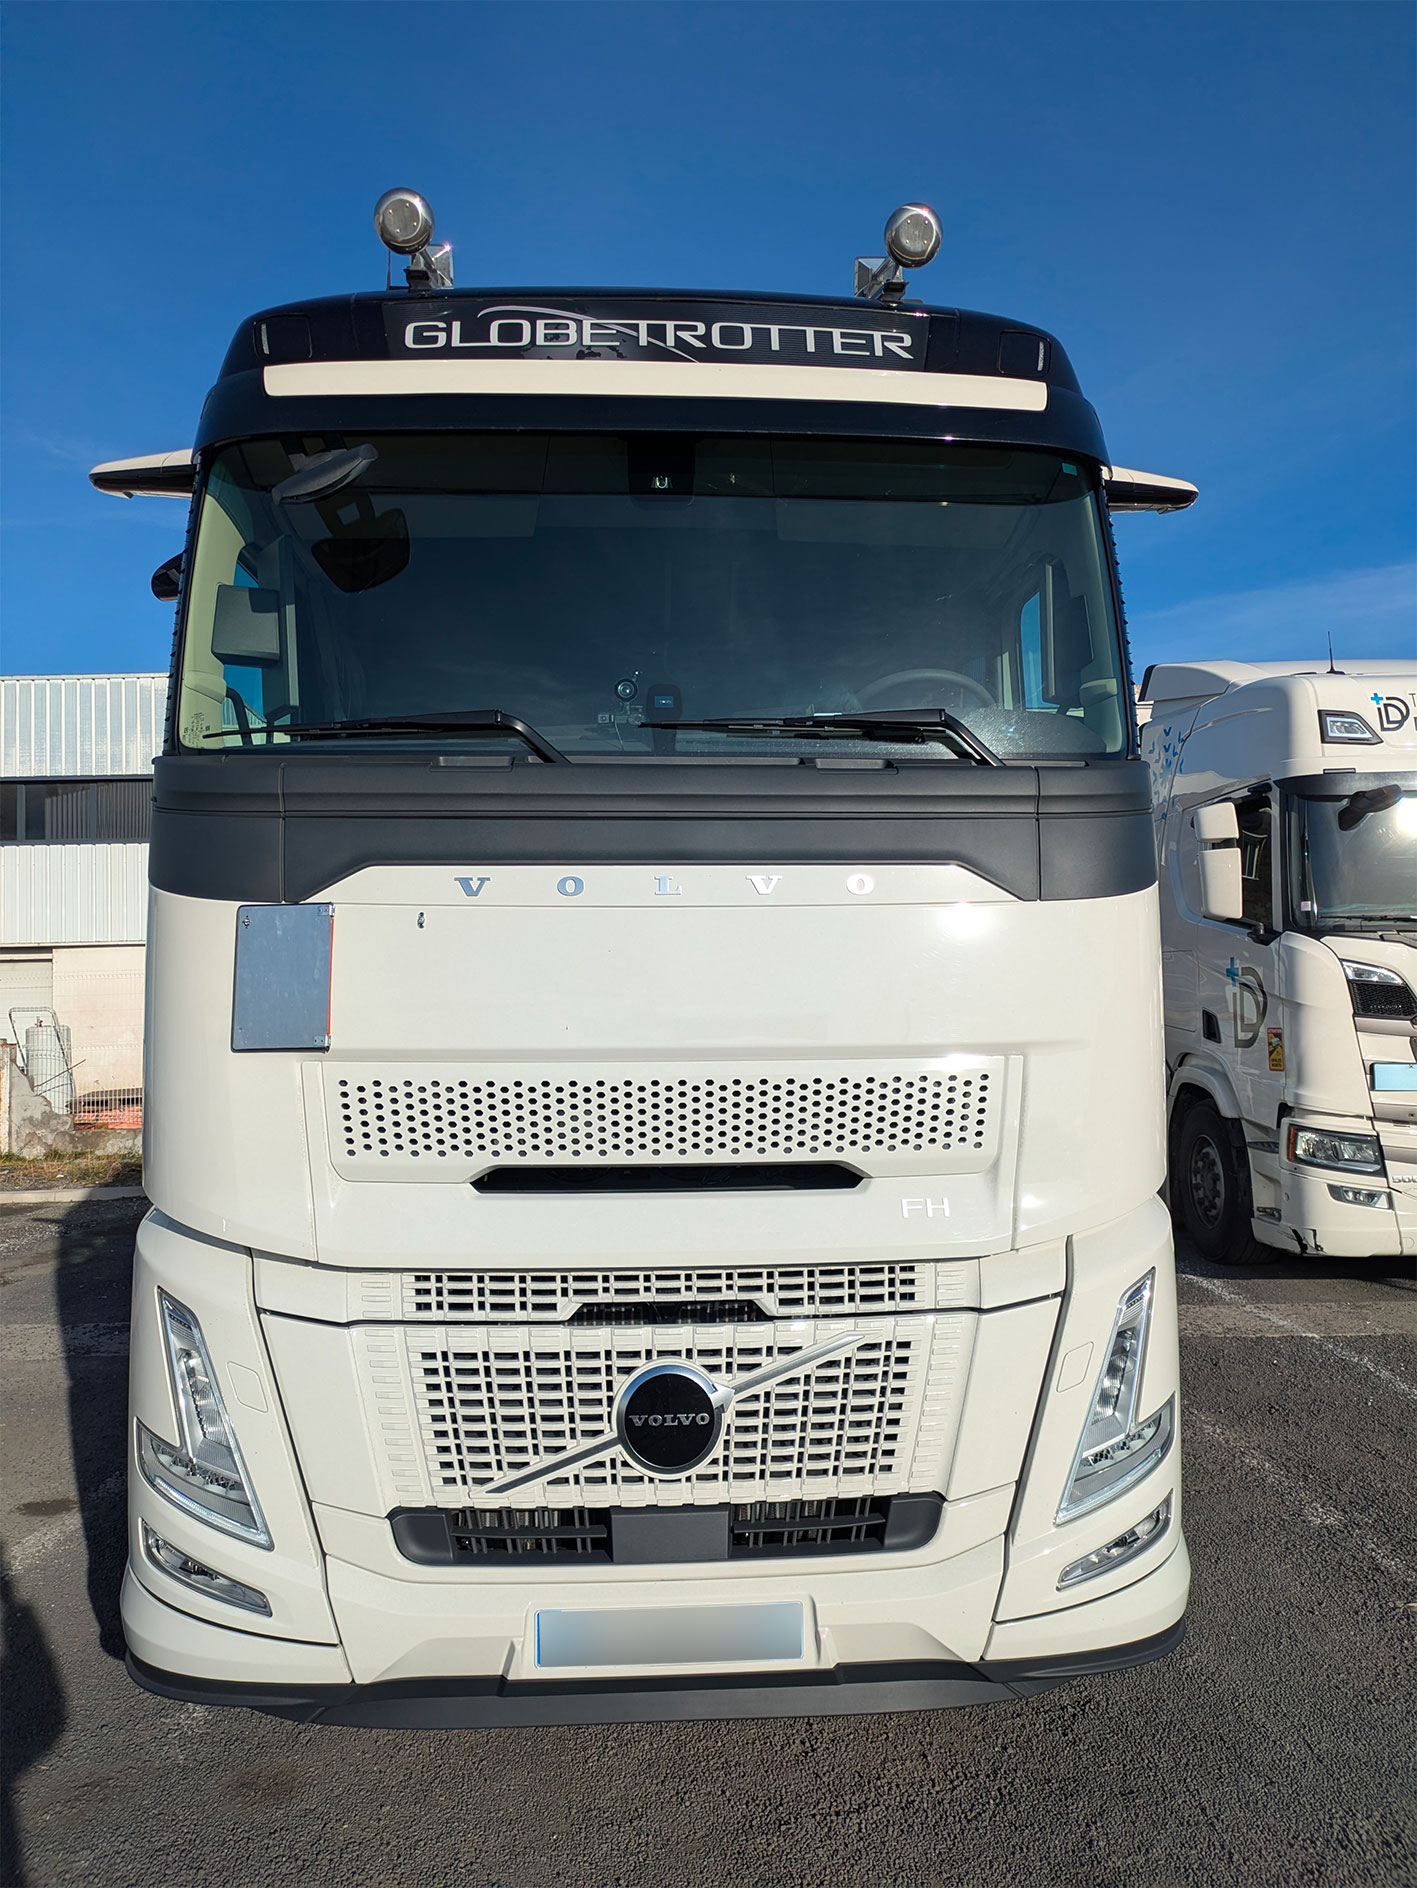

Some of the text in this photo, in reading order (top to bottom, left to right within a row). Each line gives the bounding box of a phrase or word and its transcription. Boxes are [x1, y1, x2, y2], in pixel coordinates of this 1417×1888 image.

[404, 318, 914, 359] GLOBETROTTER
[454, 873, 876, 897] VOLVO
[900, 1197, 950, 1218] FH
[628, 1412, 711, 1427] VOLVO
